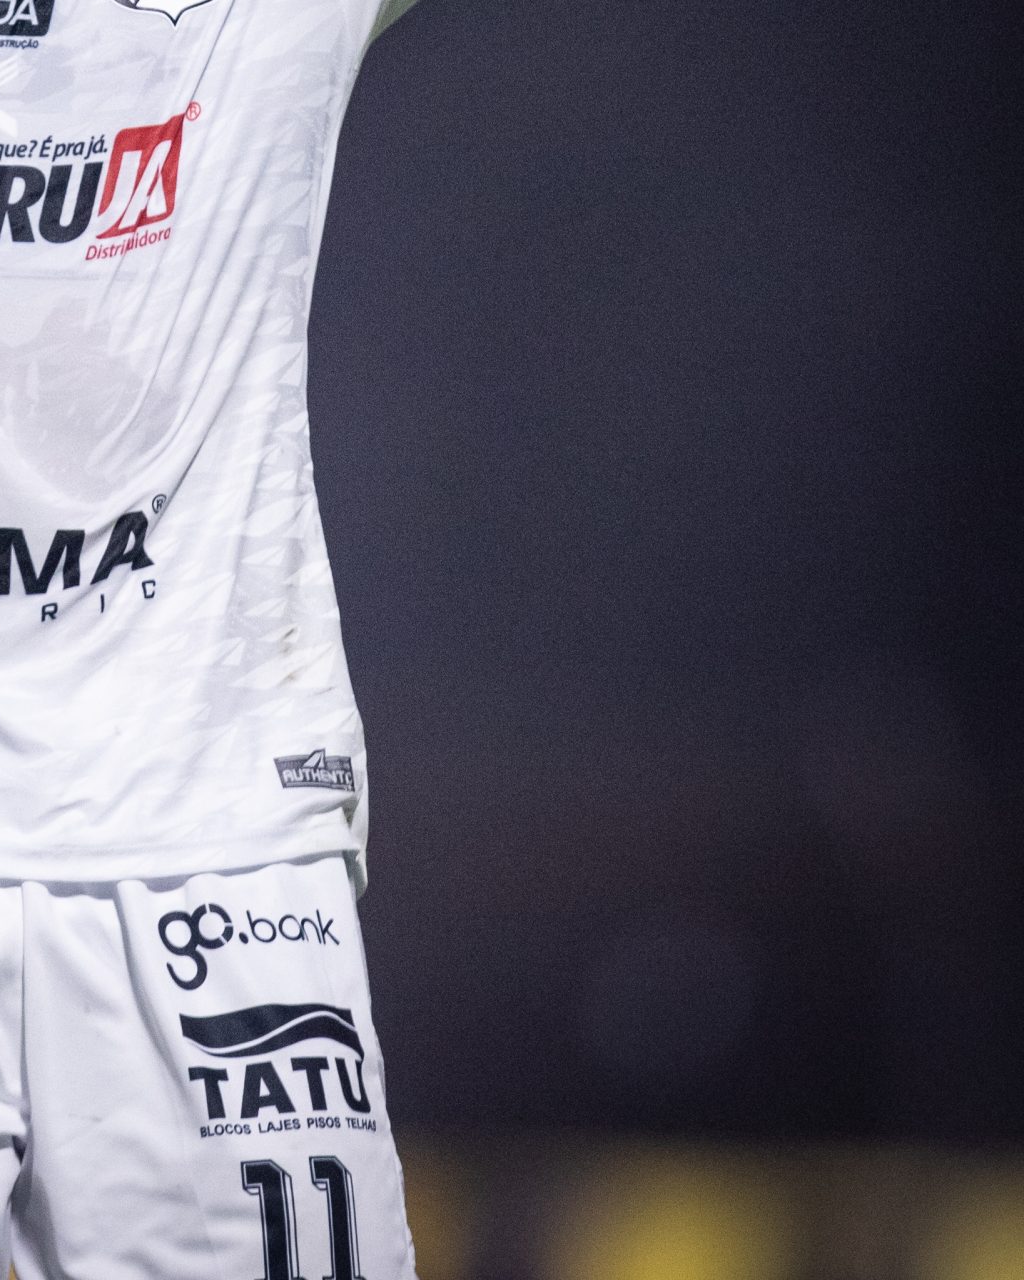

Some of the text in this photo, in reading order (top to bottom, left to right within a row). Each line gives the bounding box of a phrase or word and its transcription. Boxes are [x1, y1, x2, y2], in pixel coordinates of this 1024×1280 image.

[39, 135, 53, 158] É
[52, 142, 85, 162] pra
[84, 134, 108, 160] já.
[282, 767, 353, 786] AUTHENTC
[188, 1056, 372, 1121] TATU
[199, 1116, 377, 1139] BLOCOS LAJES PISOS TELHAS
[240, 1155, 368, 1280] 11
